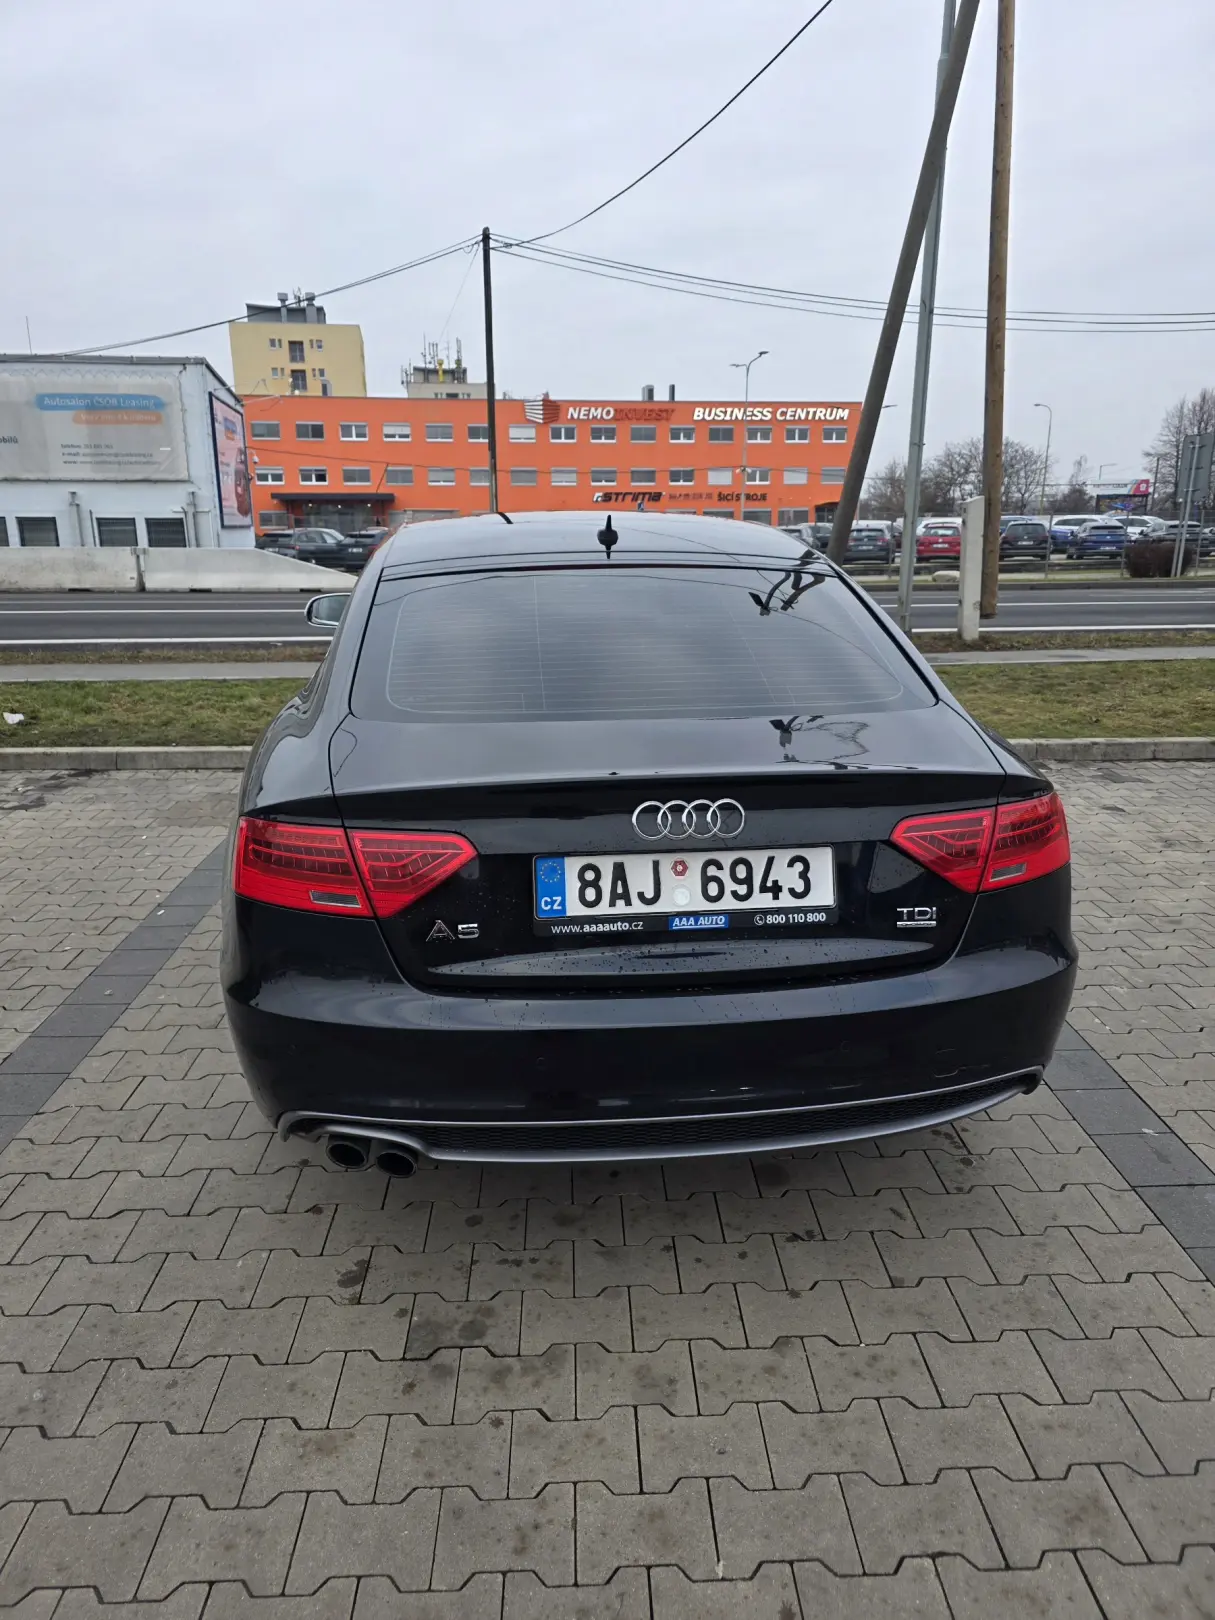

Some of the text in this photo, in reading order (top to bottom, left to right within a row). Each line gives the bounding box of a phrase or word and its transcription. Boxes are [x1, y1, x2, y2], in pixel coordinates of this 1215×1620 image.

[43, 396, 91, 407] Autosalon
[120, 397, 156, 410] Leasing
[693, 406, 850, 421] BUSINESS CENTRUM
[576, 855, 811, 909] 8AJ 6943
[541, 896, 562, 910] CZ
[766, 912, 827, 925] 800 110 800
[896, 906, 937, 920] TDI
[551, 920, 644, 934] www.aaaauto.cz
[672, 915, 726, 928] AAA AUTO
[425, 919, 480, 942] A5
